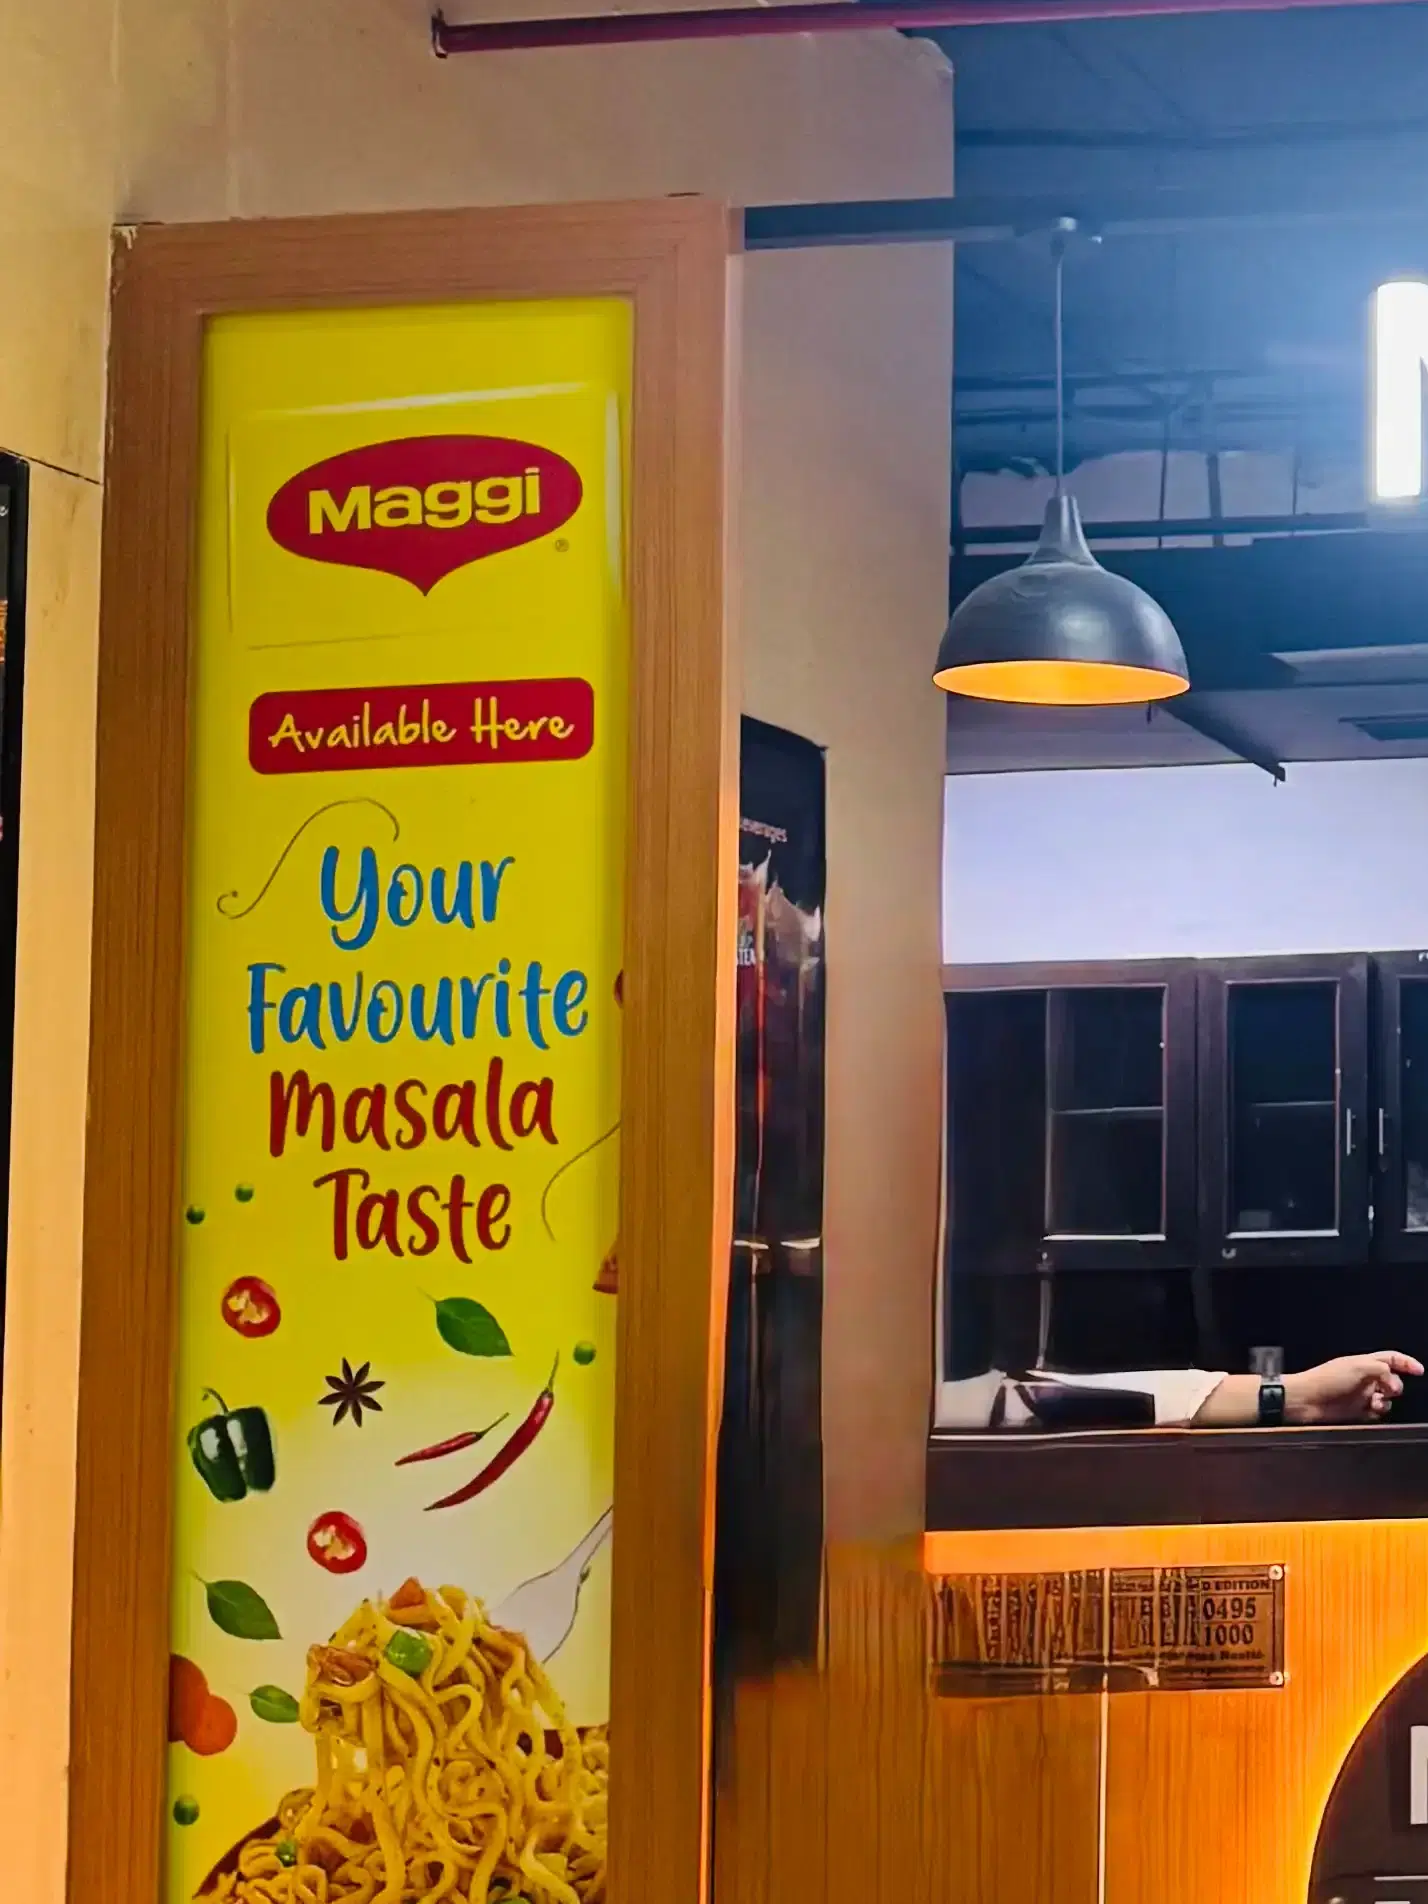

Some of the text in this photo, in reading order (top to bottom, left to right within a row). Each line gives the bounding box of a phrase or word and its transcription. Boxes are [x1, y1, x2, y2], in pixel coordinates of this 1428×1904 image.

[308, 466, 540, 534] Maggi
[268, 696, 574, 752] Available Here
[319, 845, 515, 950] Your
[247, 958, 588, 1054] Favourite
[313, 1168, 511, 1264] Taste
